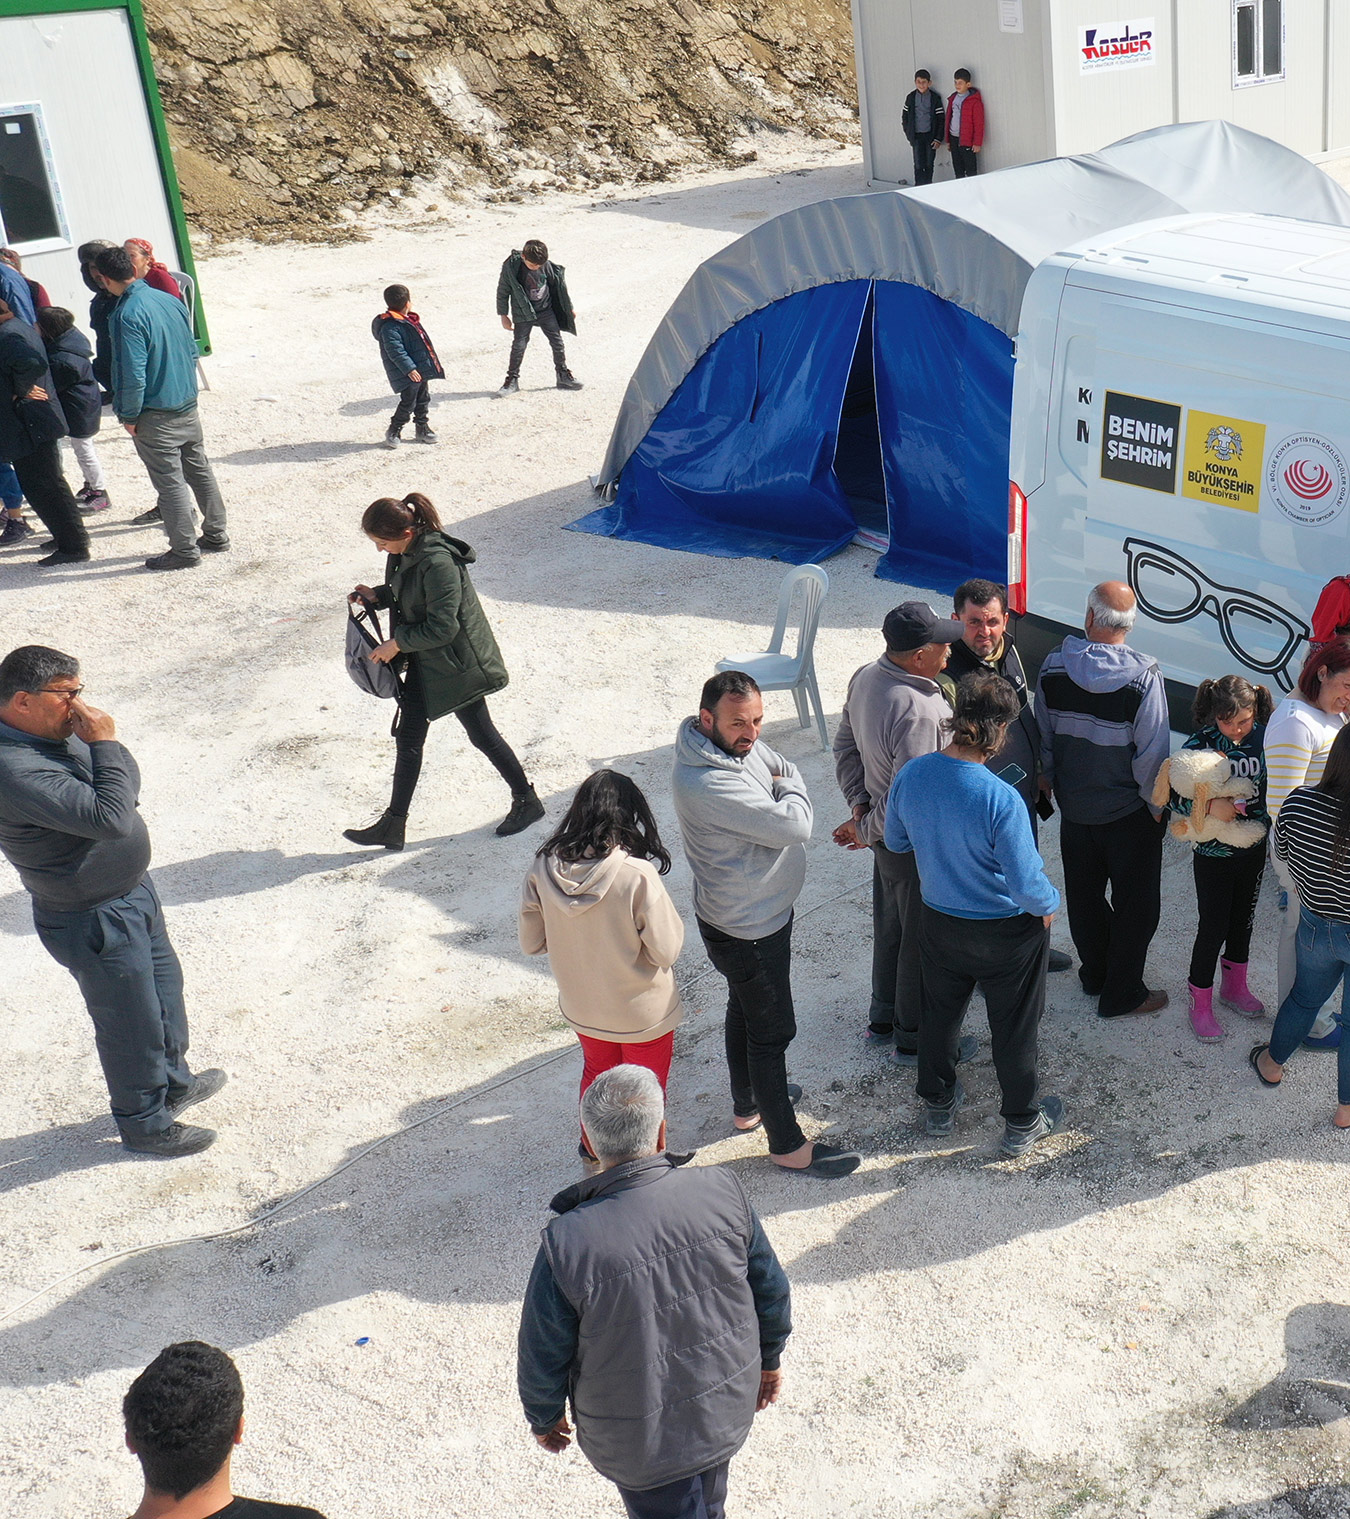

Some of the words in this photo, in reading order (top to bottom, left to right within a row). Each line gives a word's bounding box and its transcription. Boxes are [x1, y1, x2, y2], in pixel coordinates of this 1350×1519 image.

[1108, 414, 1174, 448] BENİM
[1107, 440, 1172, 470] ŞEHRİM
[1269, 459, 1278, 482] BÖLGE
[1275, 442, 1291, 460] KONYA
[1187, 469, 1255, 495] BÜYÜKŞEHİR
[1205, 462, 1238, 478] KONYA
[1200, 486, 1240, 501] BELEDİYESİ
